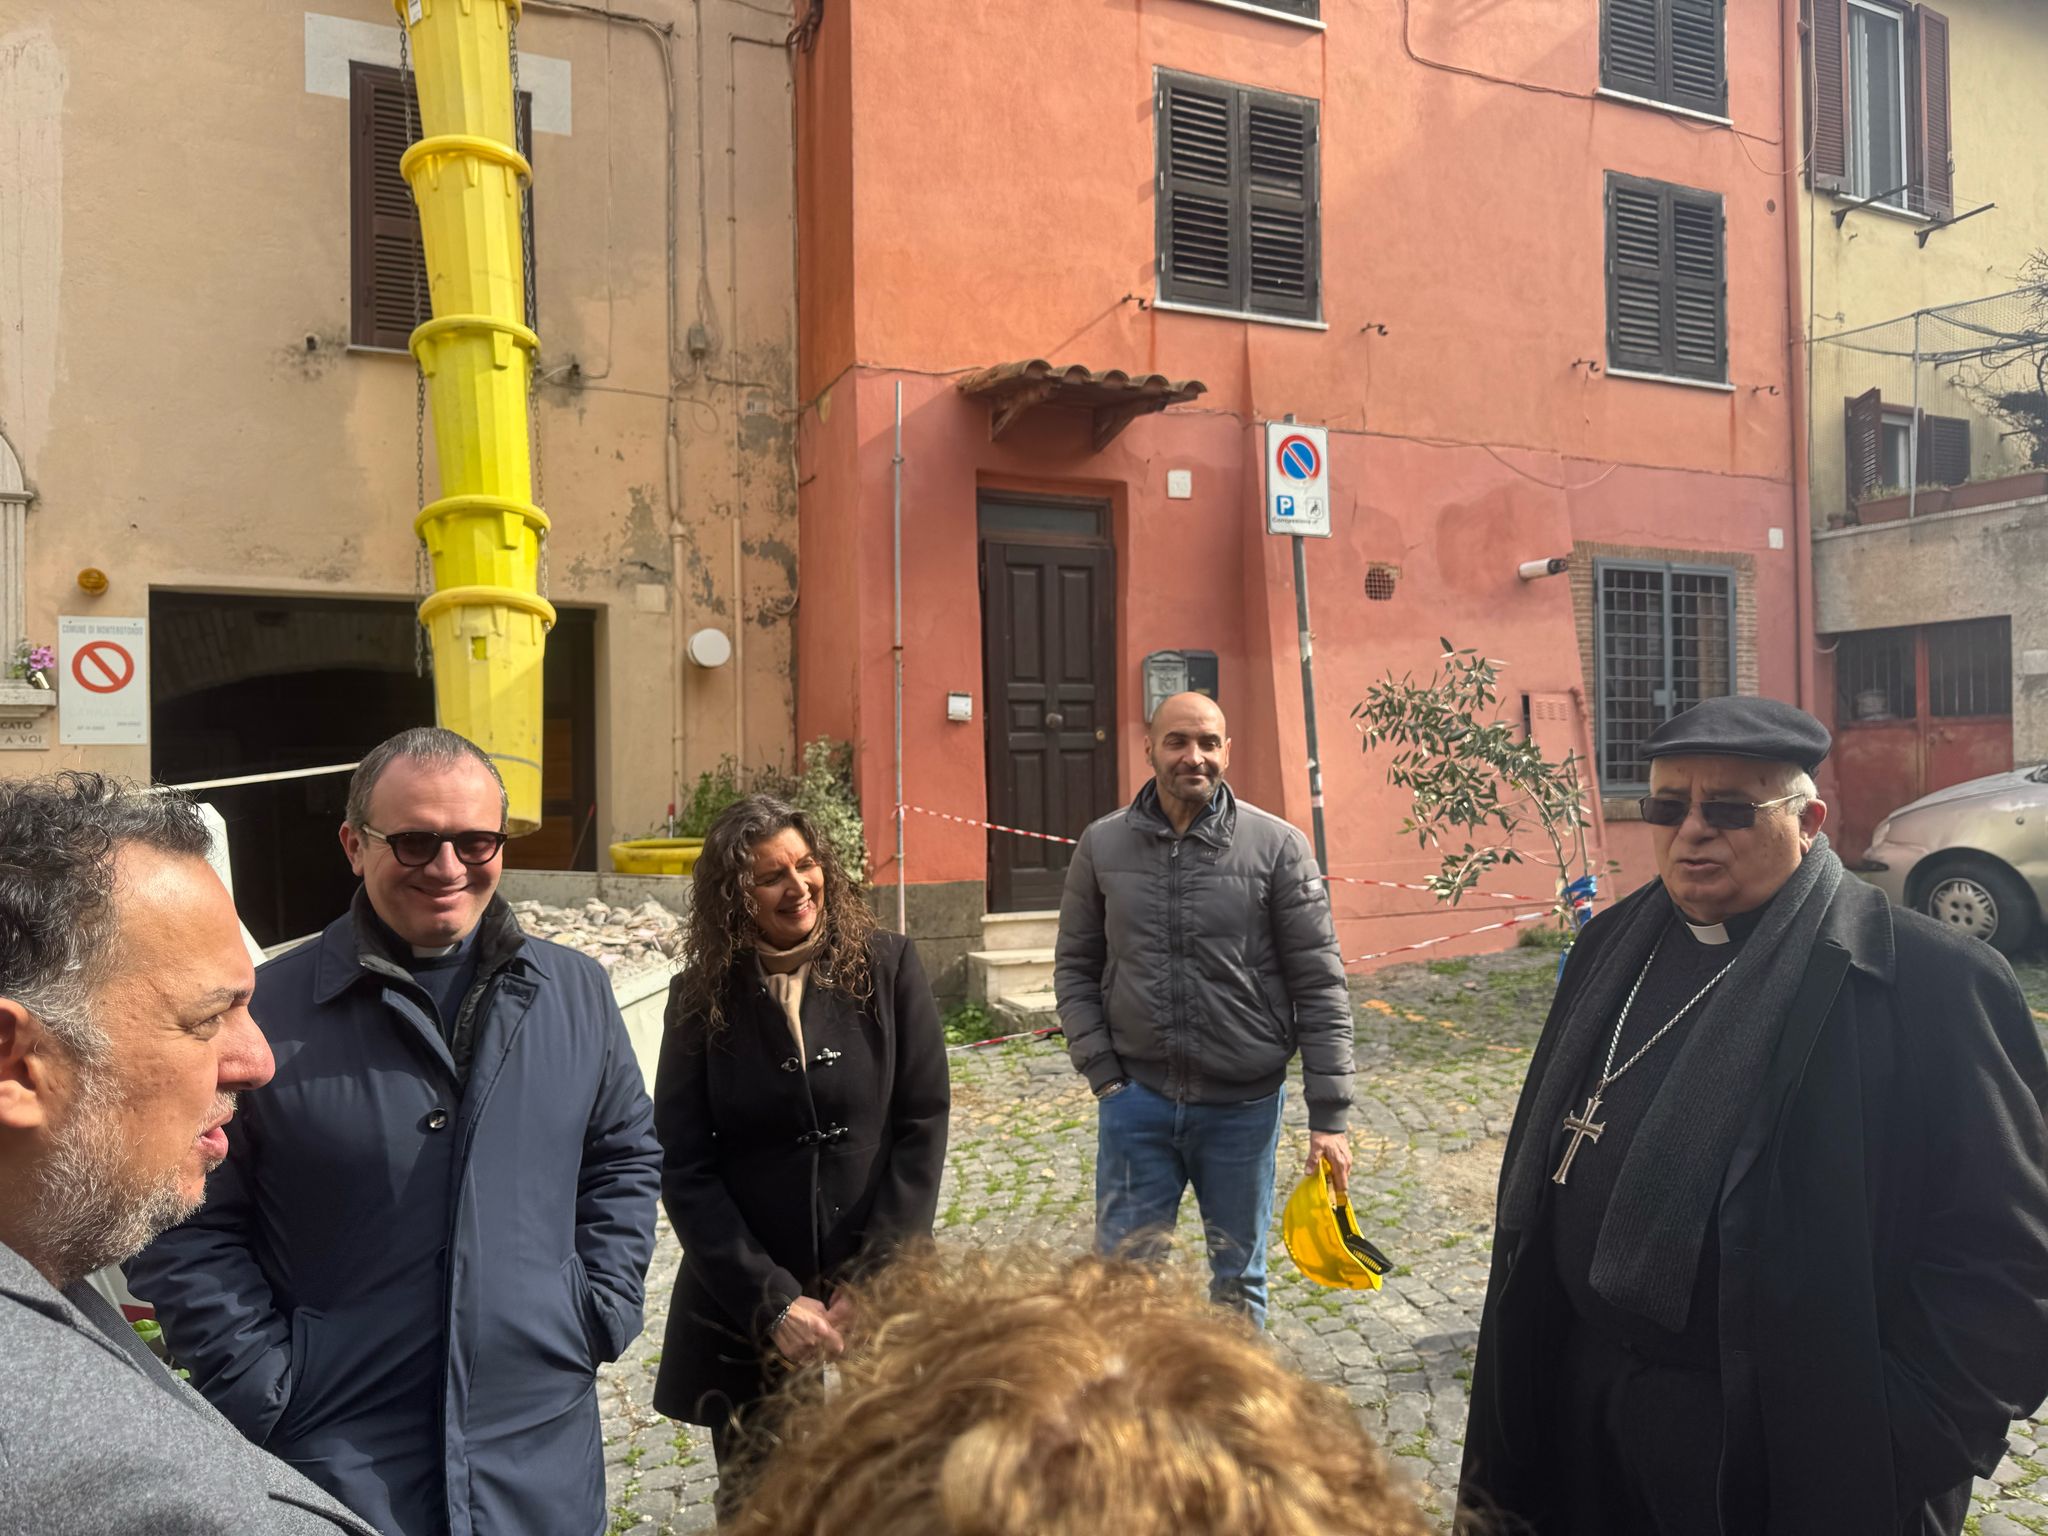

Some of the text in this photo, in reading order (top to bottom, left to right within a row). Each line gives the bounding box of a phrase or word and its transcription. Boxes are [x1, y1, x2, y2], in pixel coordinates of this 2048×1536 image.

[62, 624, 86, 635] COMUNE
[88, 625, 95, 635] DI
[5, 735, 42, 744] A VOI
